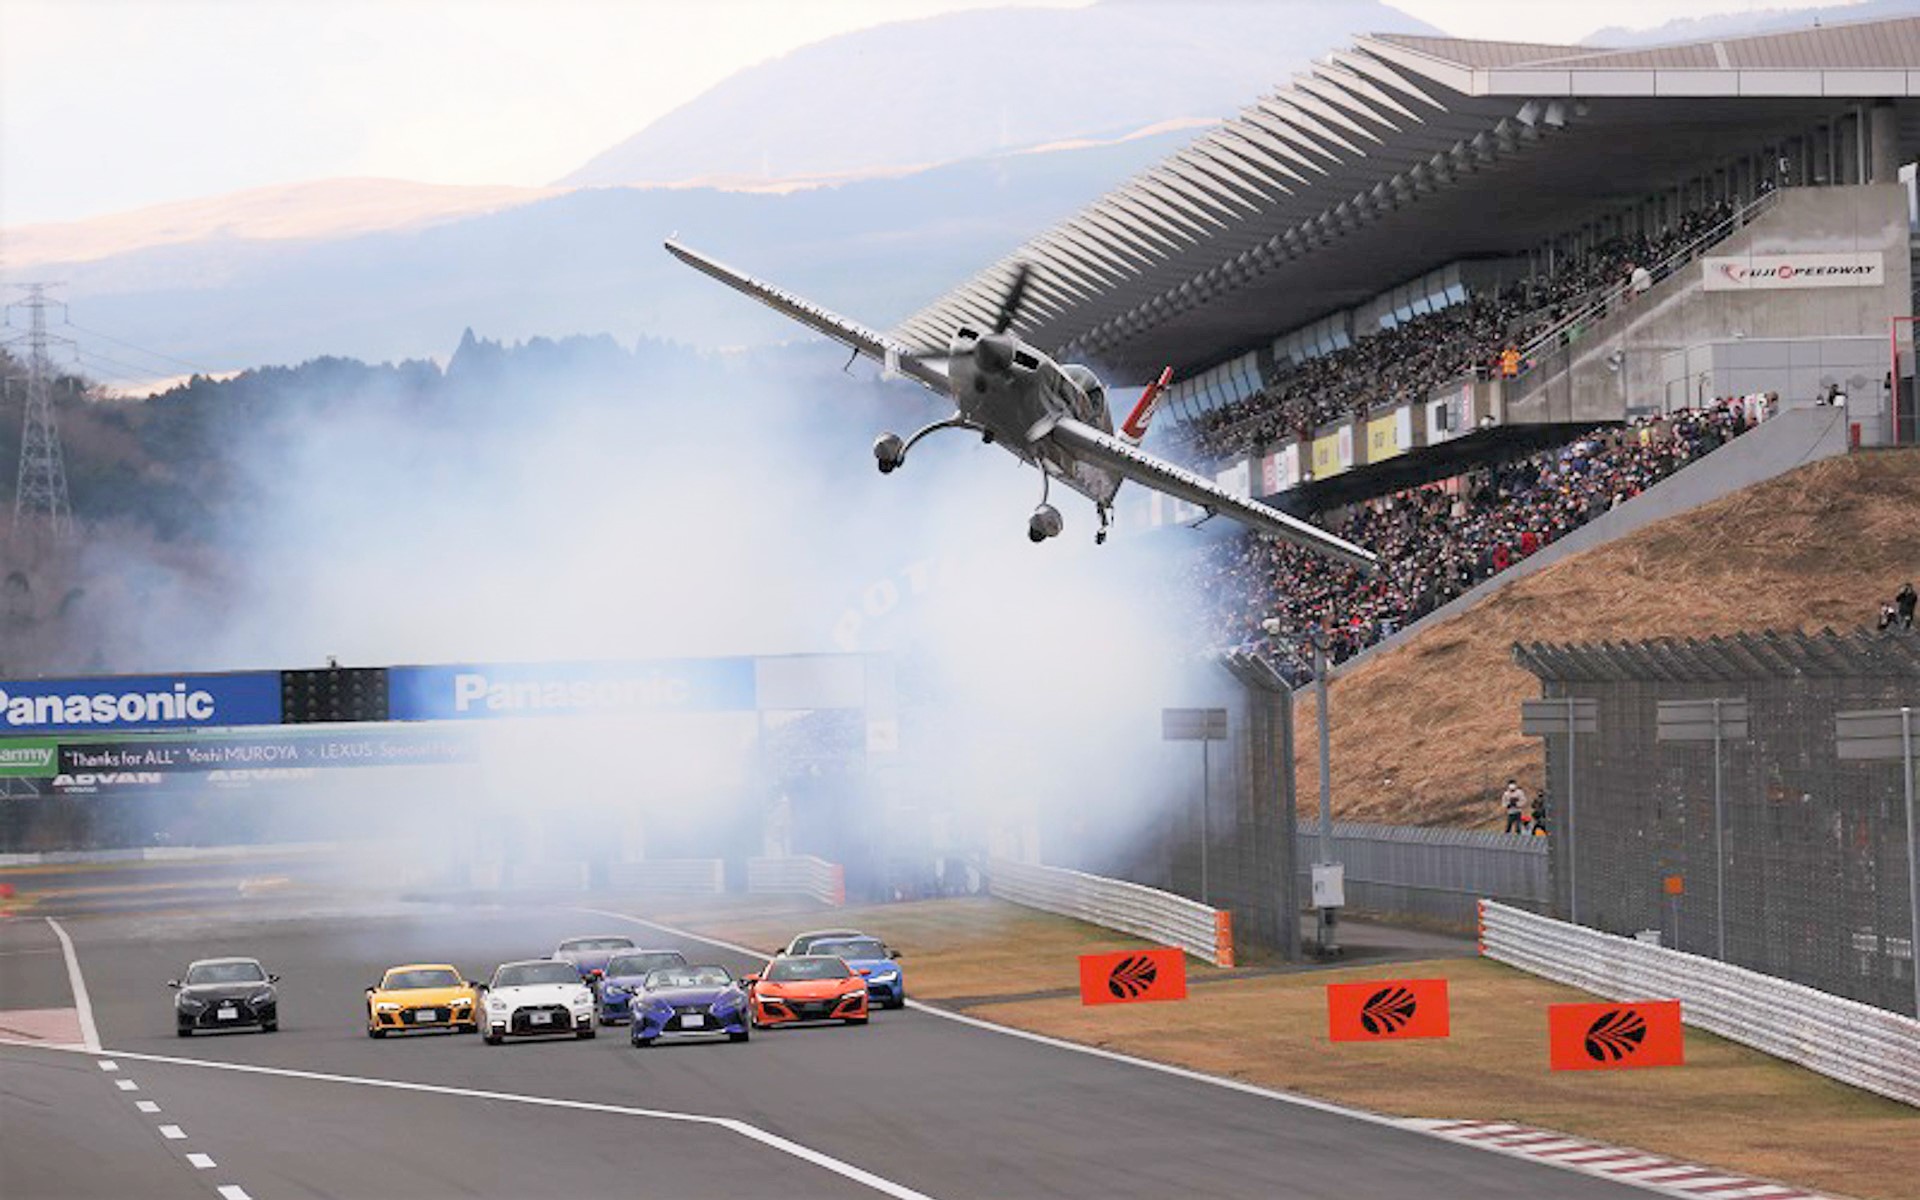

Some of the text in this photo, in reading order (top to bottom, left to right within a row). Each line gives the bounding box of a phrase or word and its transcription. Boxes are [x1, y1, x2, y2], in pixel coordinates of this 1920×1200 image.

[0, 682, 215, 725] anasonic
[455, 672, 691, 712] Panasonic
[121, 749, 143, 766] for
[187, 747, 223, 763] Yoshi
[225, 744, 299, 762] MUROYA
[321, 743, 374, 758] LEXUS
[52, 772, 162, 786] ADVAN
